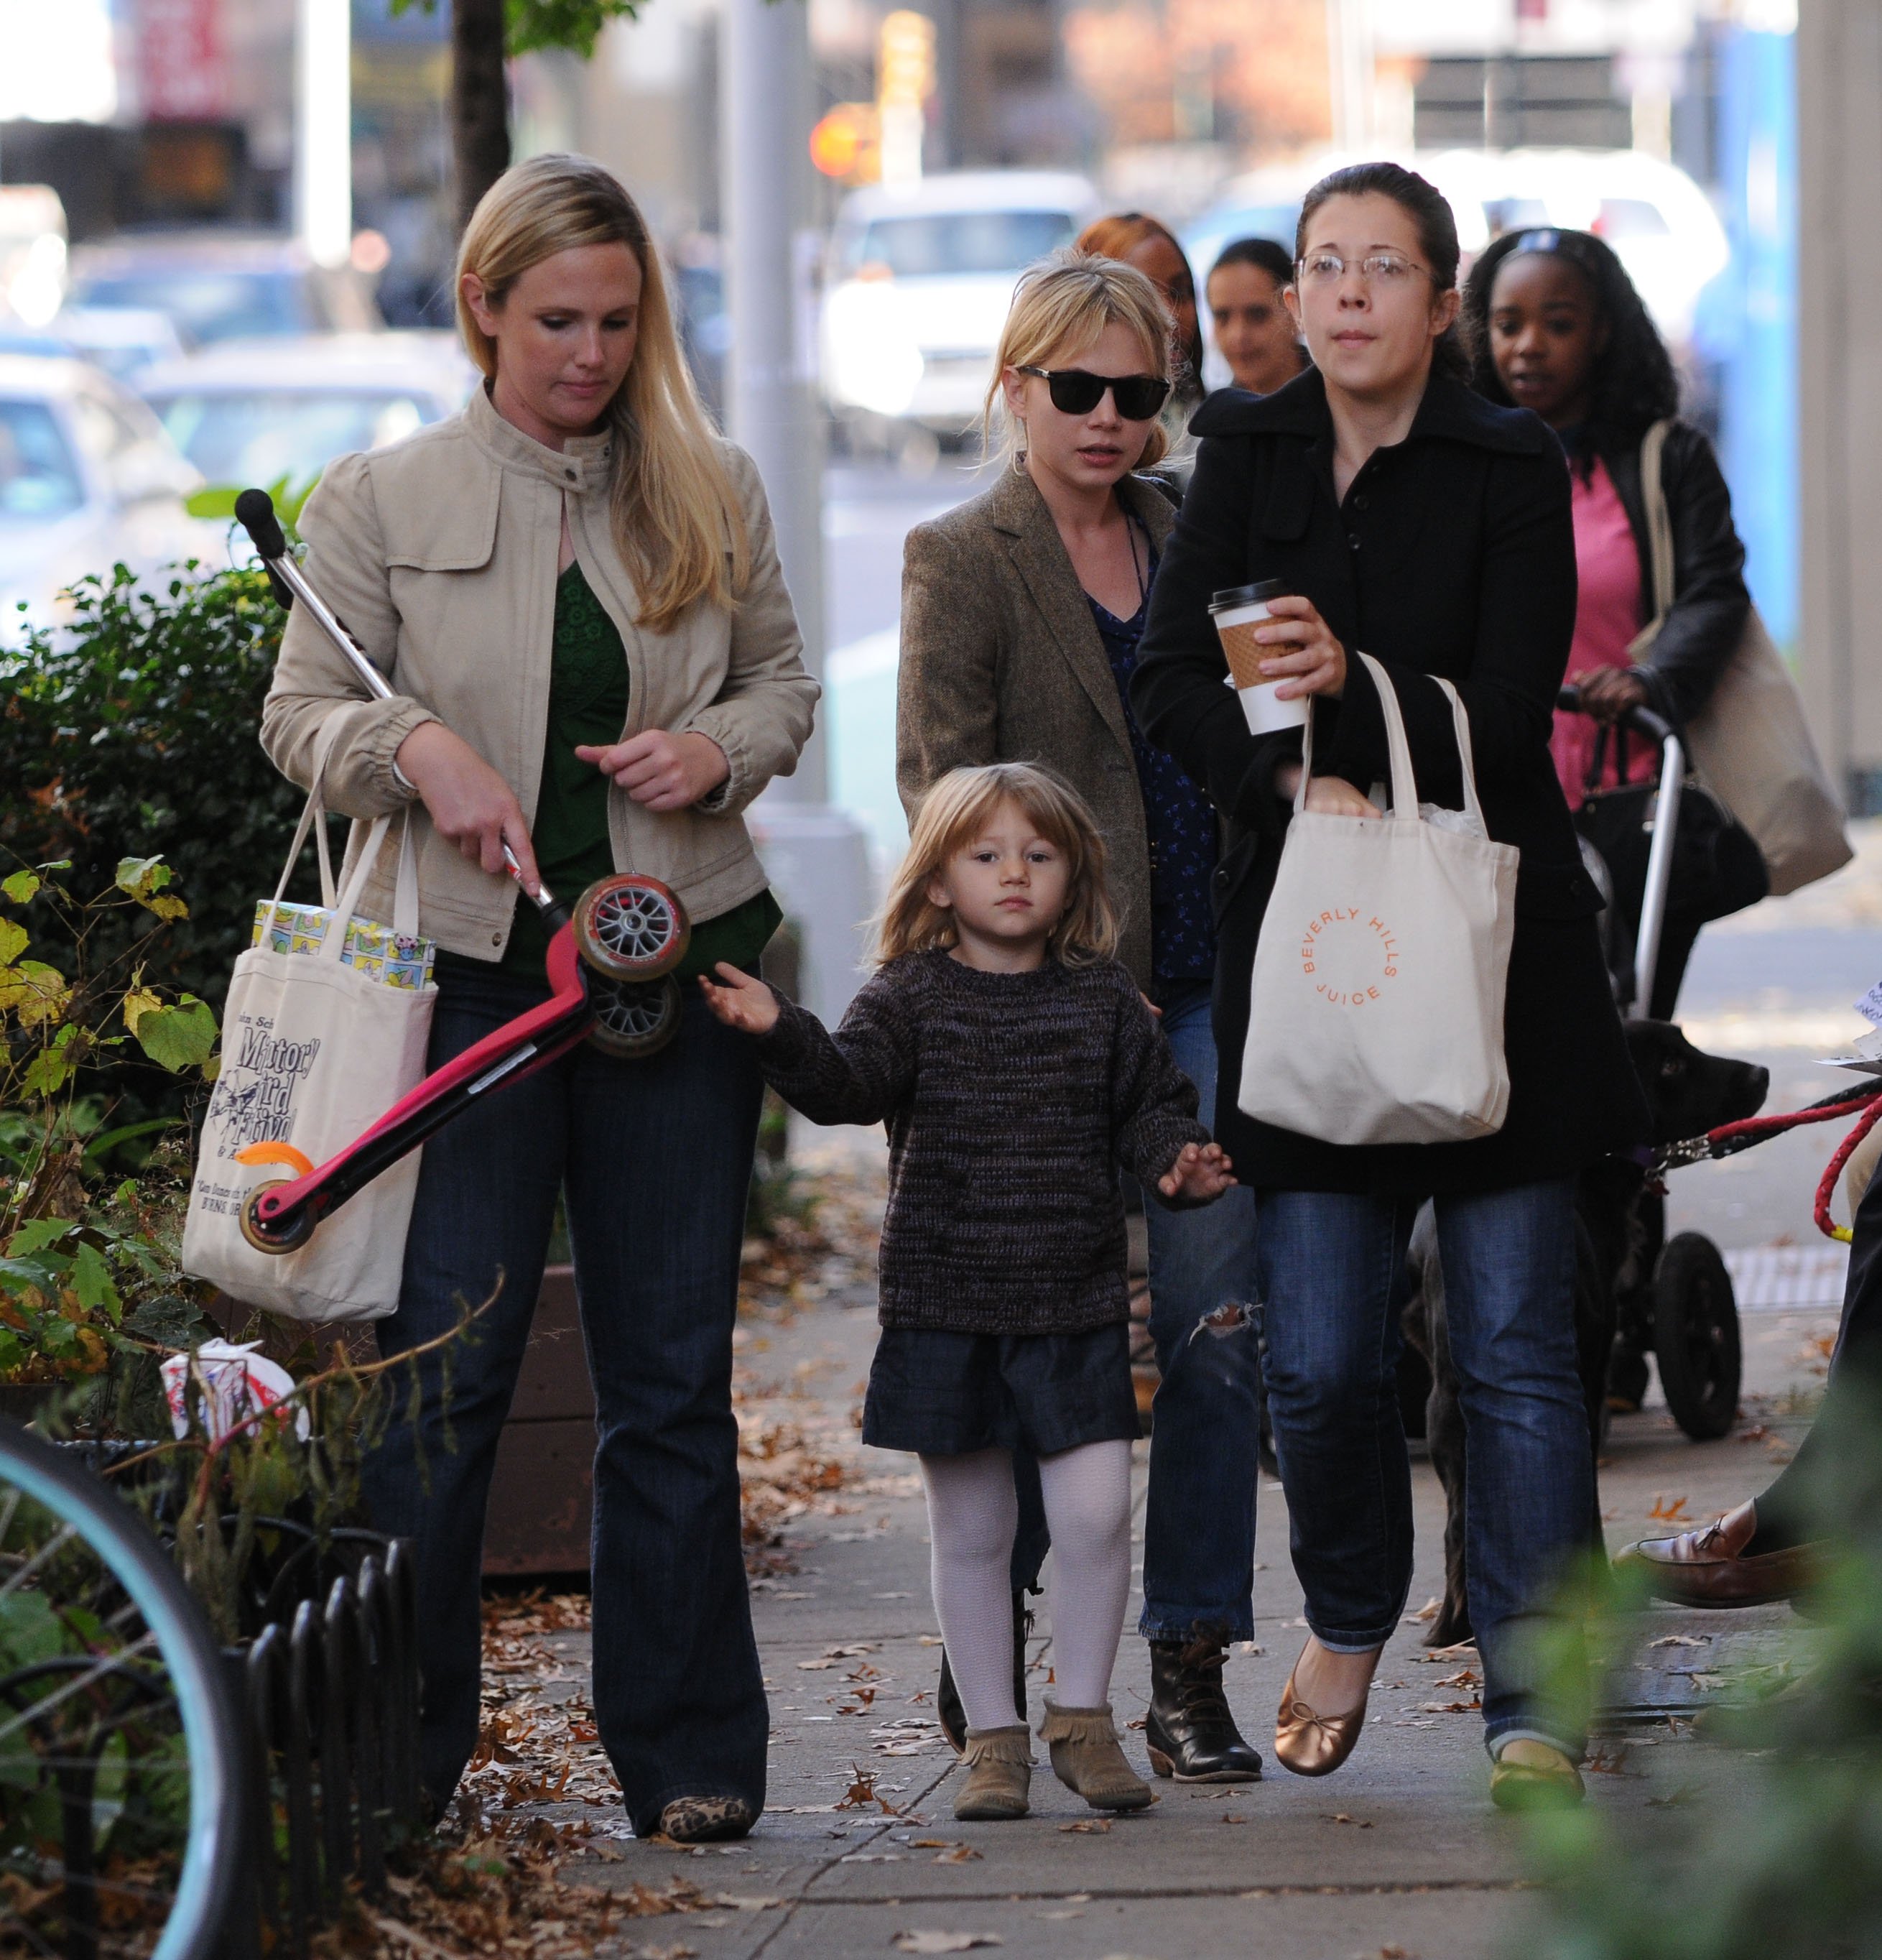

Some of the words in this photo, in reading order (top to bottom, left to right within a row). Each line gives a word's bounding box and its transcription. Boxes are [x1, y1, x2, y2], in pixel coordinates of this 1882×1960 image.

[1302, 907, 1360, 974] BEVERLY
[1368, 916, 1399, 977] HILLS
[1316, 984, 1381, 1006] JUICE
